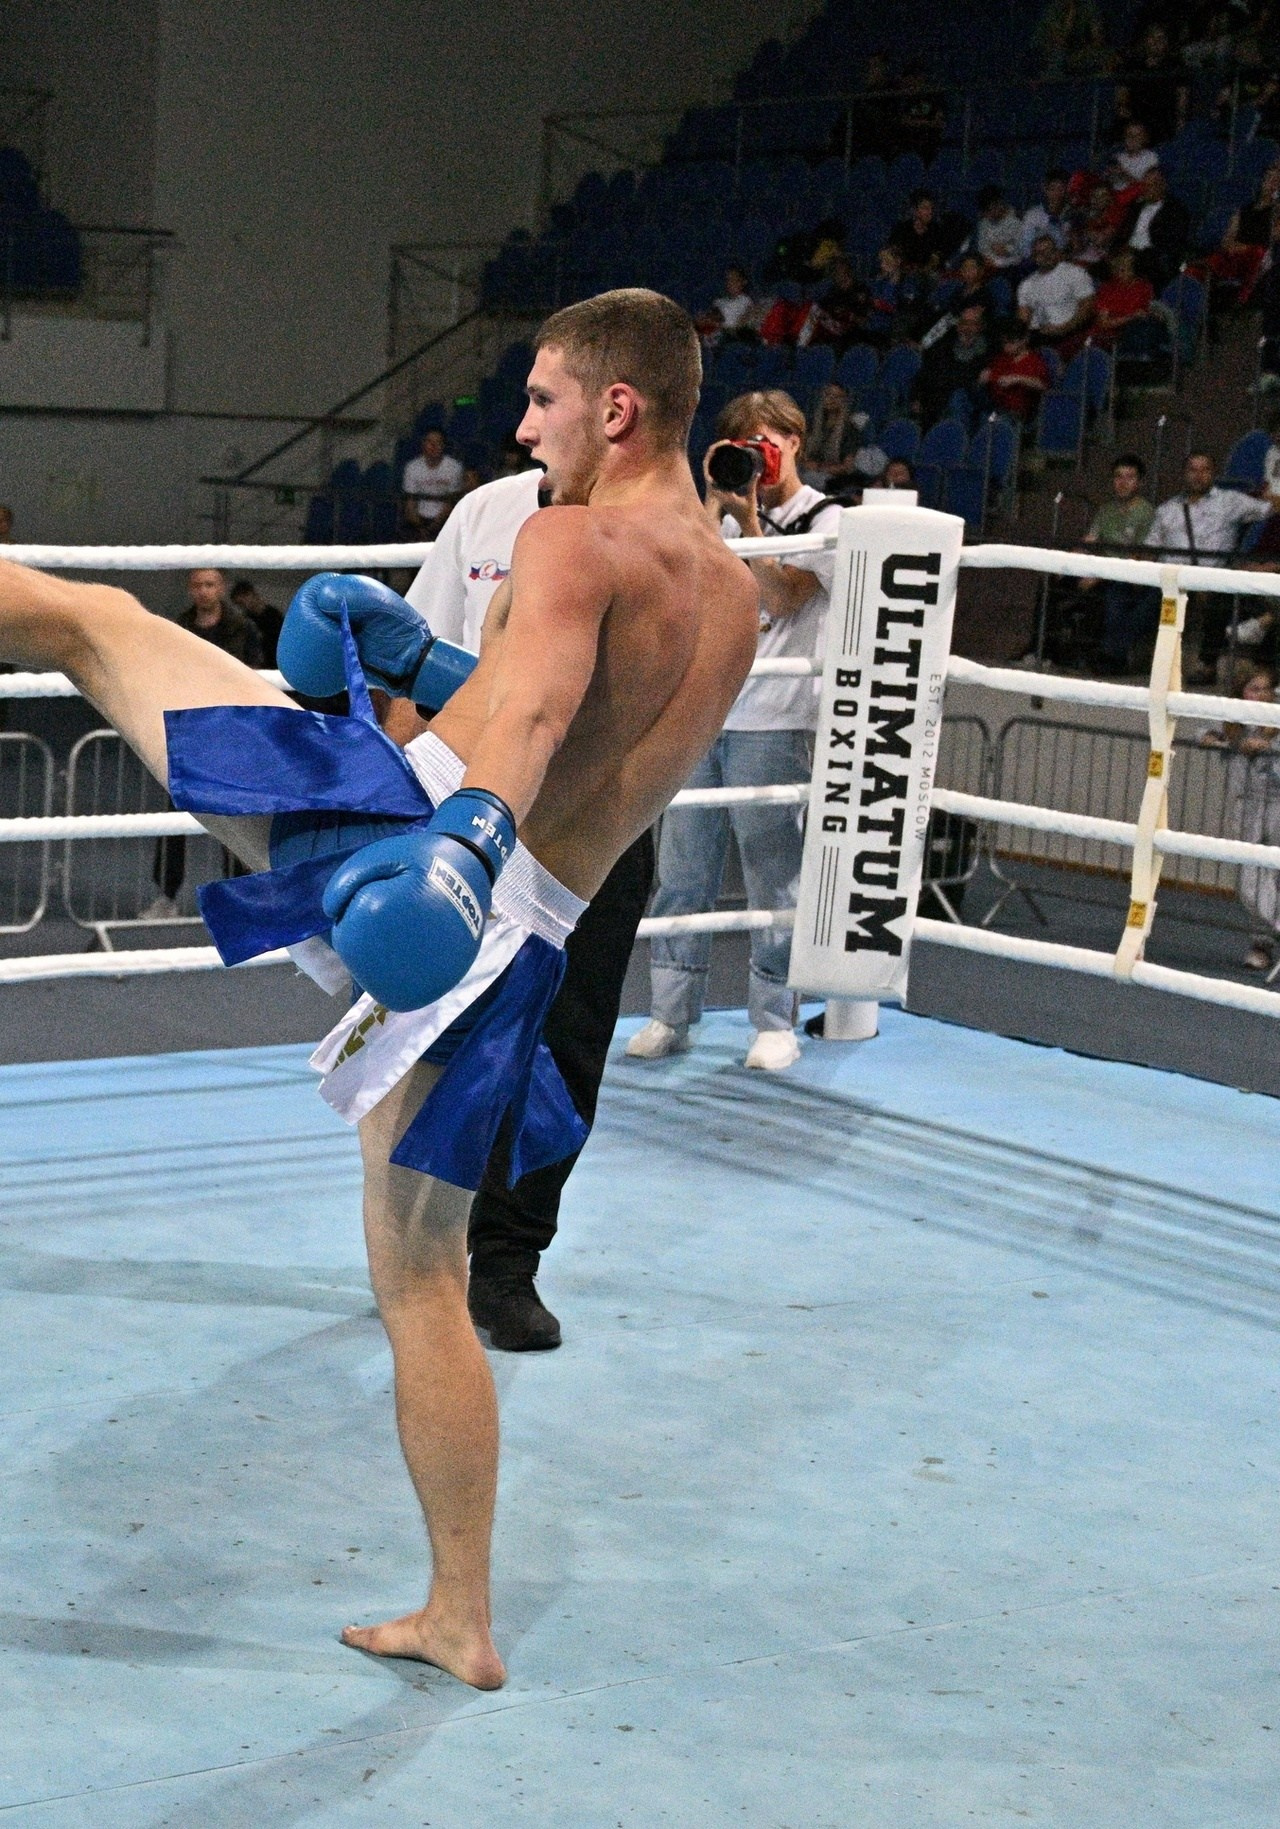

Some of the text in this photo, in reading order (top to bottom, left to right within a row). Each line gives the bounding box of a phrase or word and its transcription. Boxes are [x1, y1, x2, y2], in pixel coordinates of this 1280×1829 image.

[821, 667, 862, 834] BOXING
[844, 551, 942, 957] ULTIMATUM
[922, 719, 937, 758] 2012
[914, 766, 931, 841] MOSCOW
